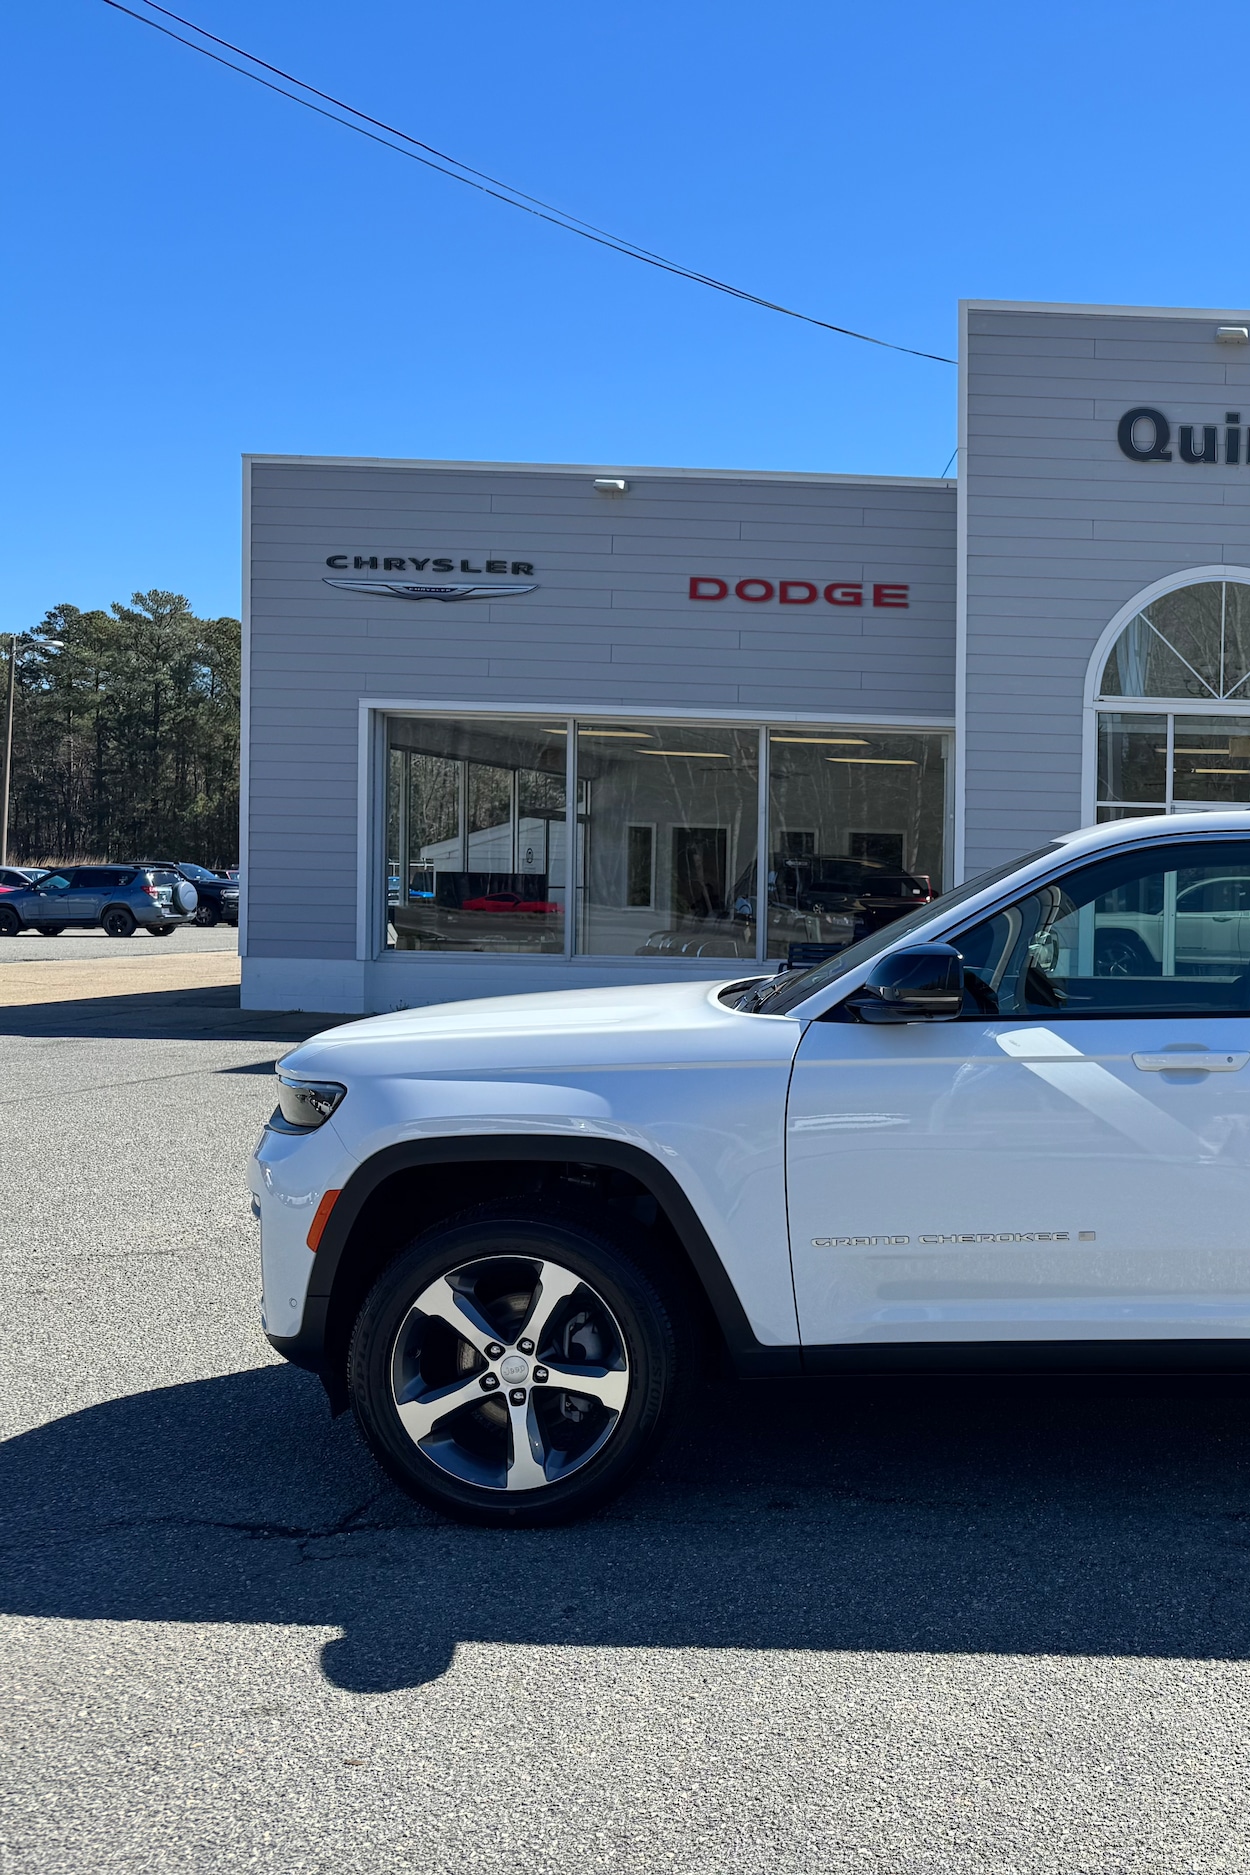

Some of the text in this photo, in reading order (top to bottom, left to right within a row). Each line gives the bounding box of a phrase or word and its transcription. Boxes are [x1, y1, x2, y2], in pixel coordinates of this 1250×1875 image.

[325, 555, 535, 576] CHRYSLER
[689, 576, 910, 609] DODGE
[810, 1231, 1070, 1248] GRAND CHEROKEE
